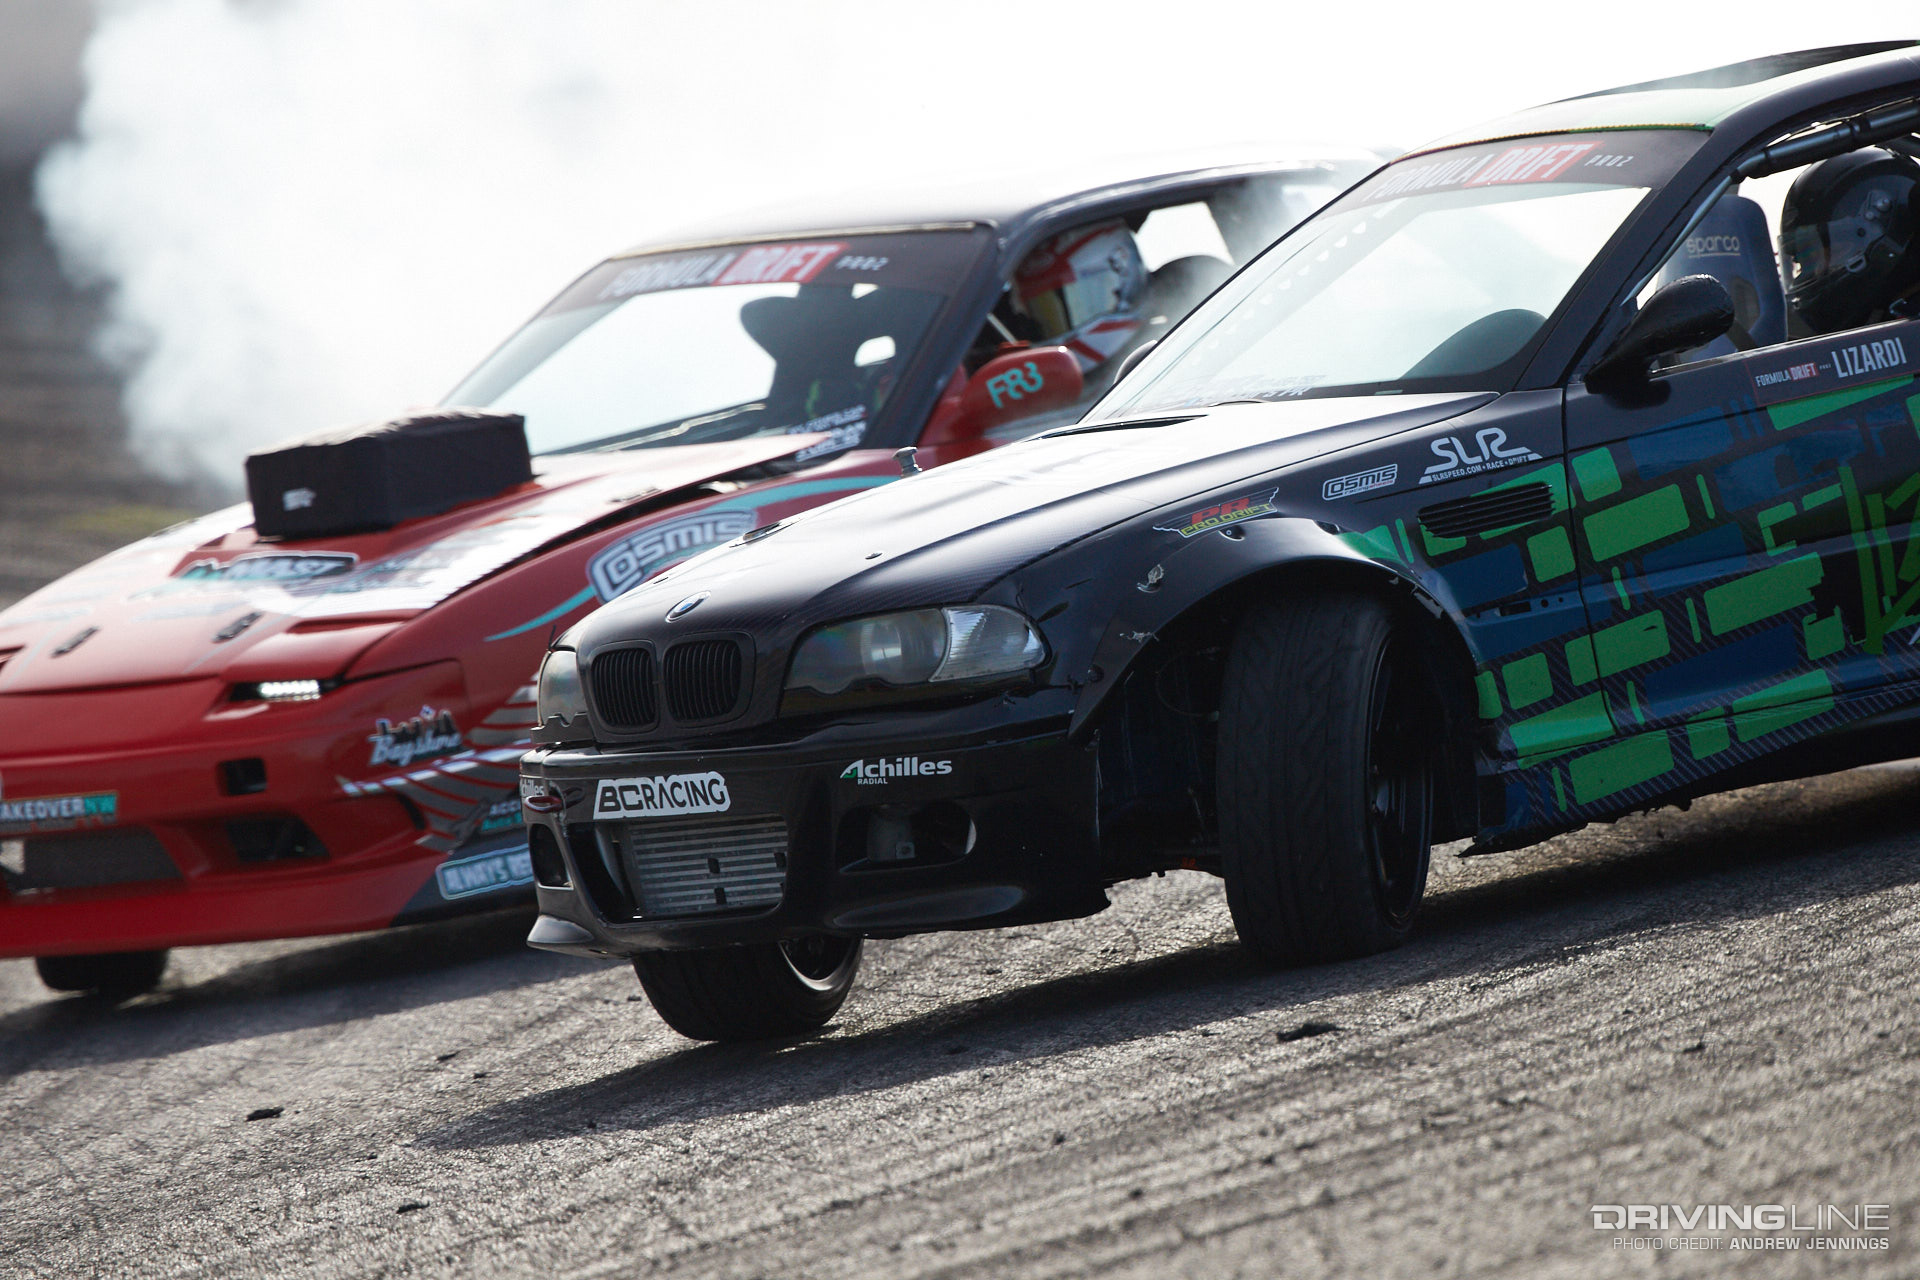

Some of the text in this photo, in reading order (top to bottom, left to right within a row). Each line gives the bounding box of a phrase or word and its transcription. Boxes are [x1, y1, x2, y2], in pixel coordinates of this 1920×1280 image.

[1471, 143, 1594, 184] DRIFT
[717, 244, 842, 284] DRIFT
[1687, 235, 1740, 258] sparco
[1755, 369, 1791, 387] FORMULA
[1790, 362, 1817, 380] DRIFT
[1831, 336, 1908, 379] LIZARDI
[1424, 427, 1532, 475] SLR
[840, 757, 952, 779] Achilles
